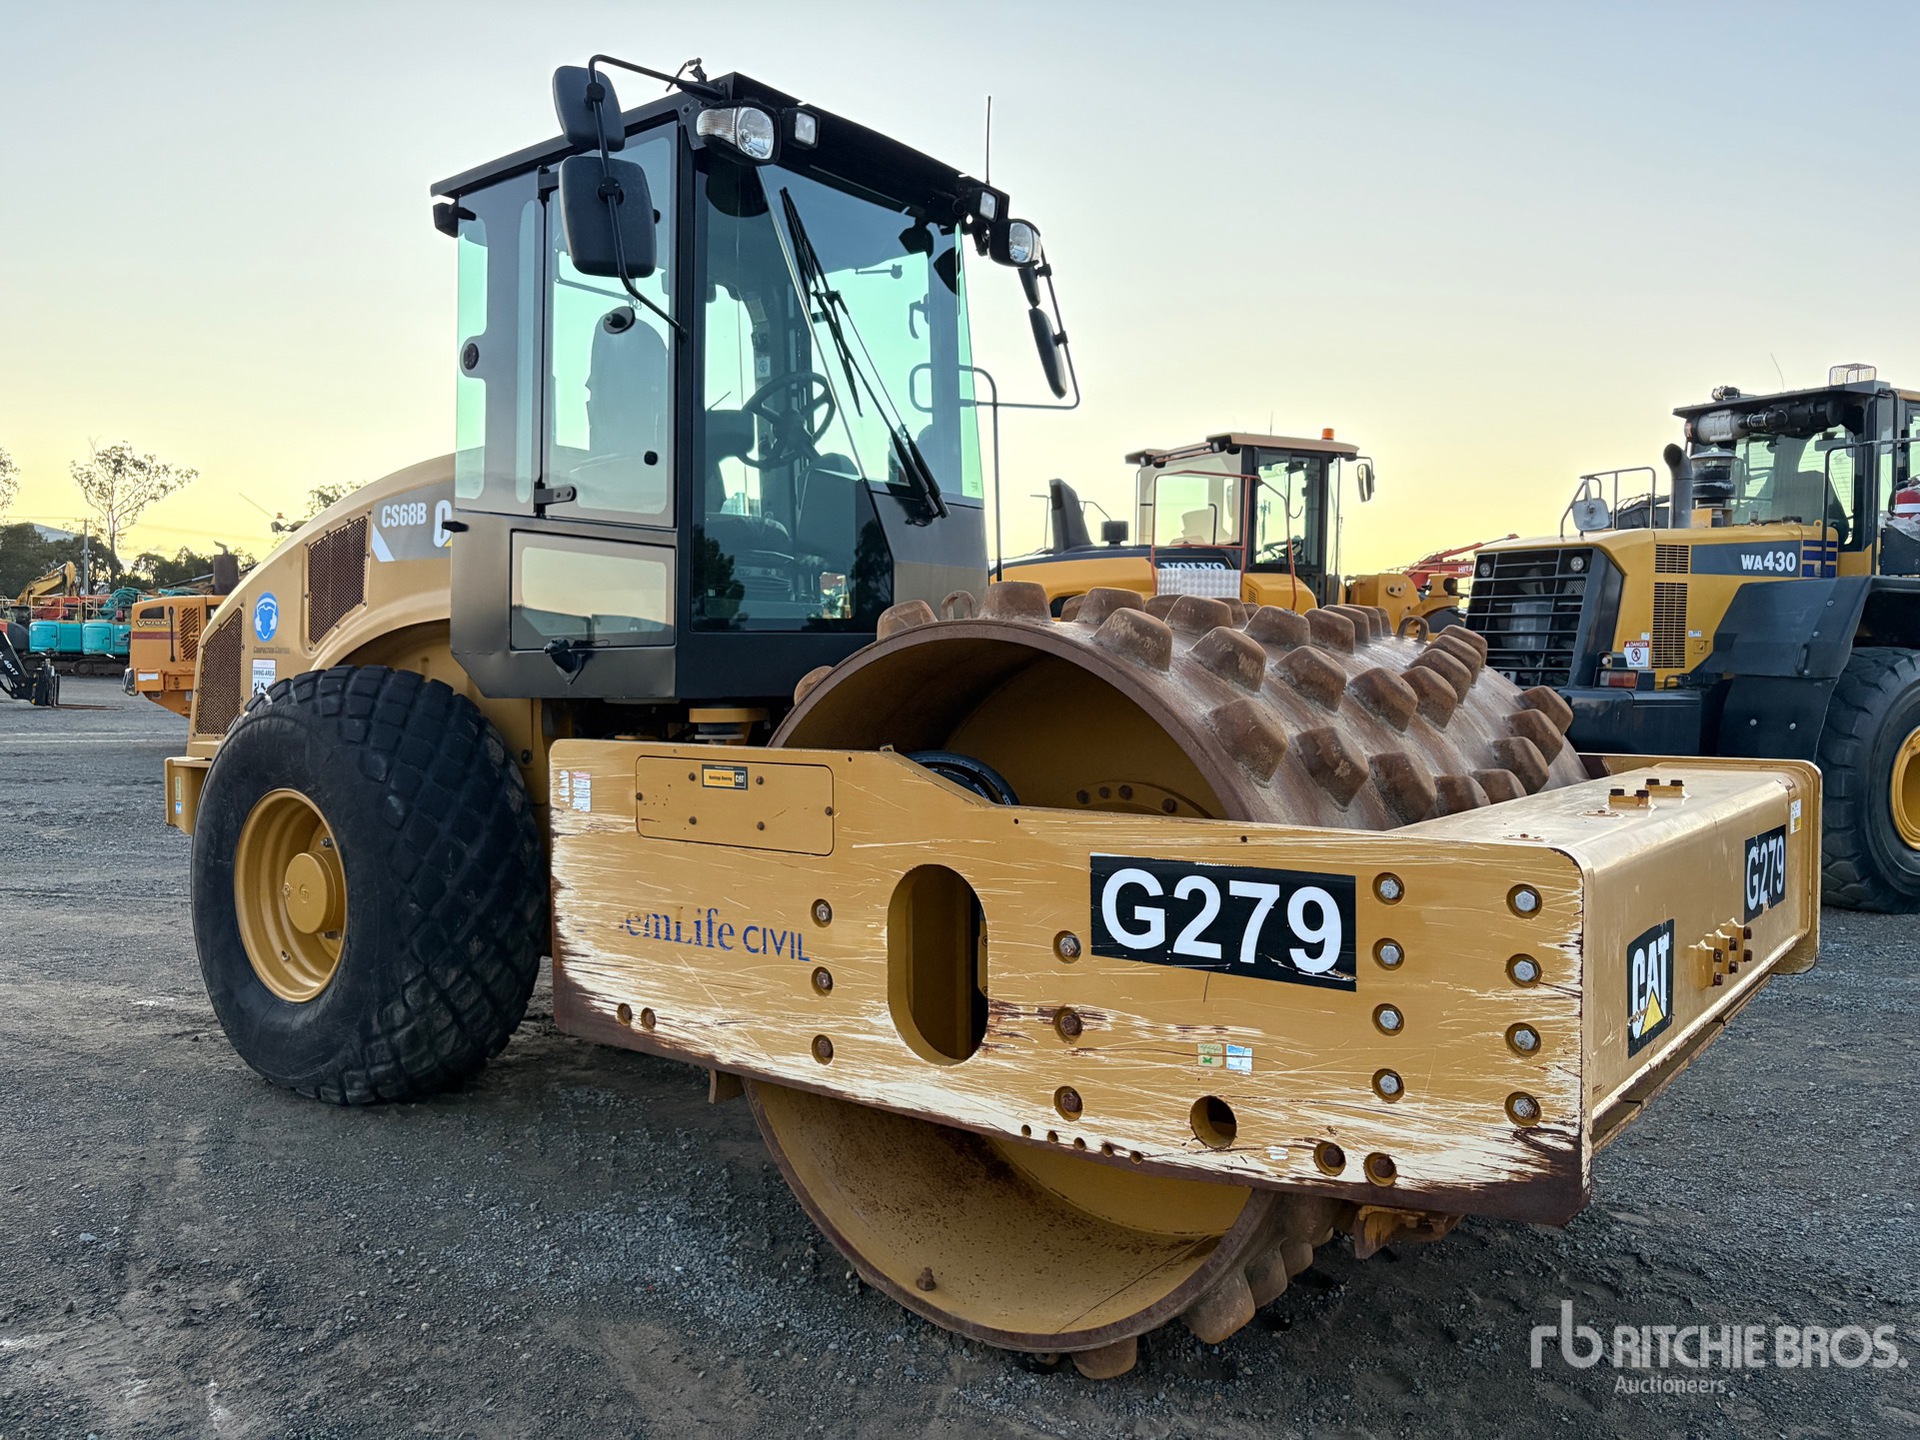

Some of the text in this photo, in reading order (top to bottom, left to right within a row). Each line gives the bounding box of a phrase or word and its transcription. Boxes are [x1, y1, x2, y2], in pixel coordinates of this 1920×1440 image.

[381, 502, 427, 528] CS68B
[1740, 551, 1797, 572] WA430
[3, 659, 19, 675] 4017
[1746, 833, 1785, 912] G279
[1101, 868, 1342, 974] G279
[742, 925, 810, 962] CIVIL
[1631, 931, 1670, 1039] CAT
